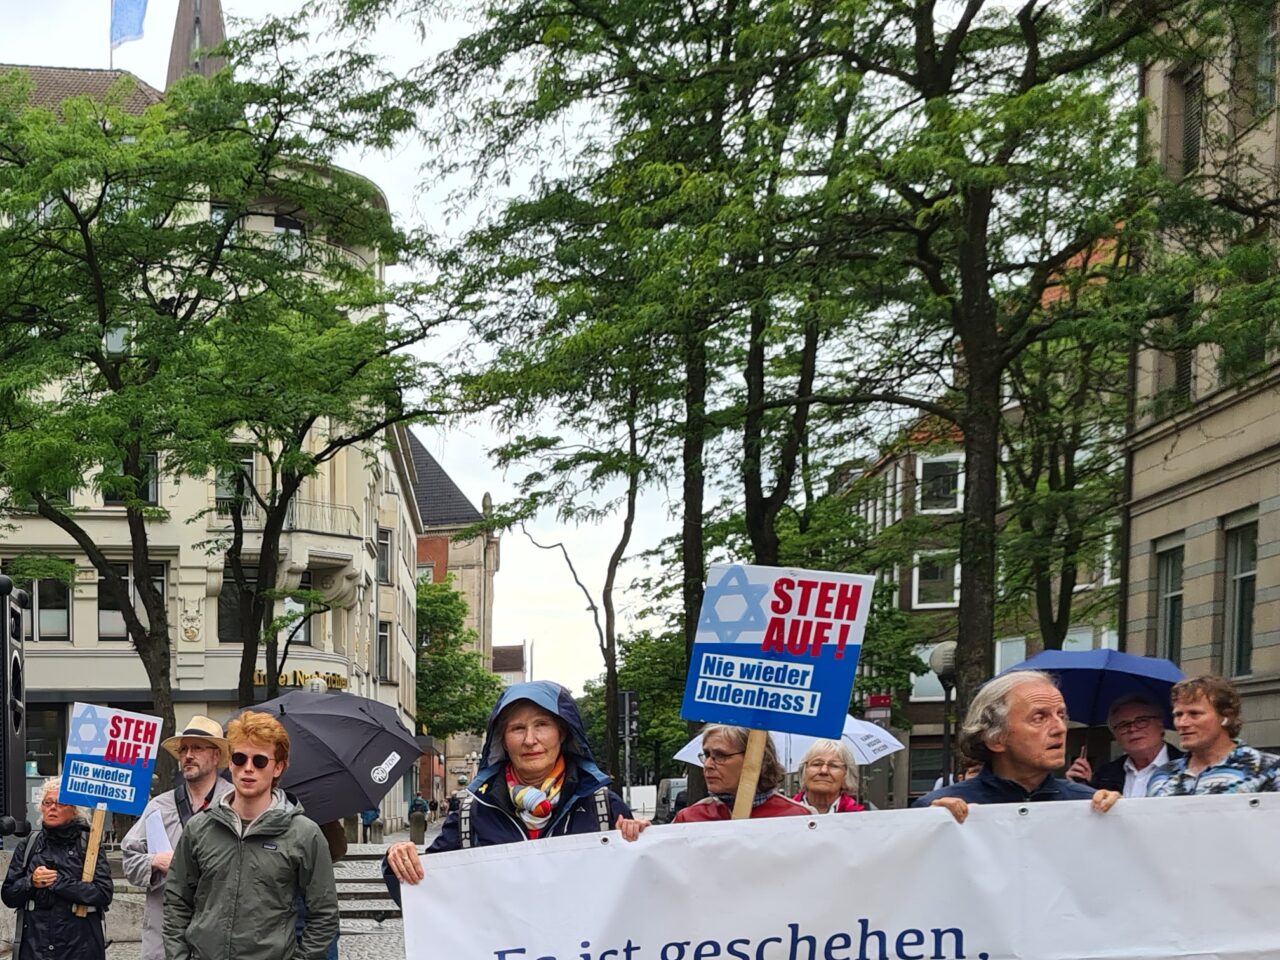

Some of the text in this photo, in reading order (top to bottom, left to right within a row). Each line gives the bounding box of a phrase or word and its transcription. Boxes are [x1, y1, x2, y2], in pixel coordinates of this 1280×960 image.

[770, 577, 862, 621] STEH
[702, 655, 810, 686] Nie wieder
[109, 715, 158, 745] STEH
[71, 761, 130, 784] Nie wieder
